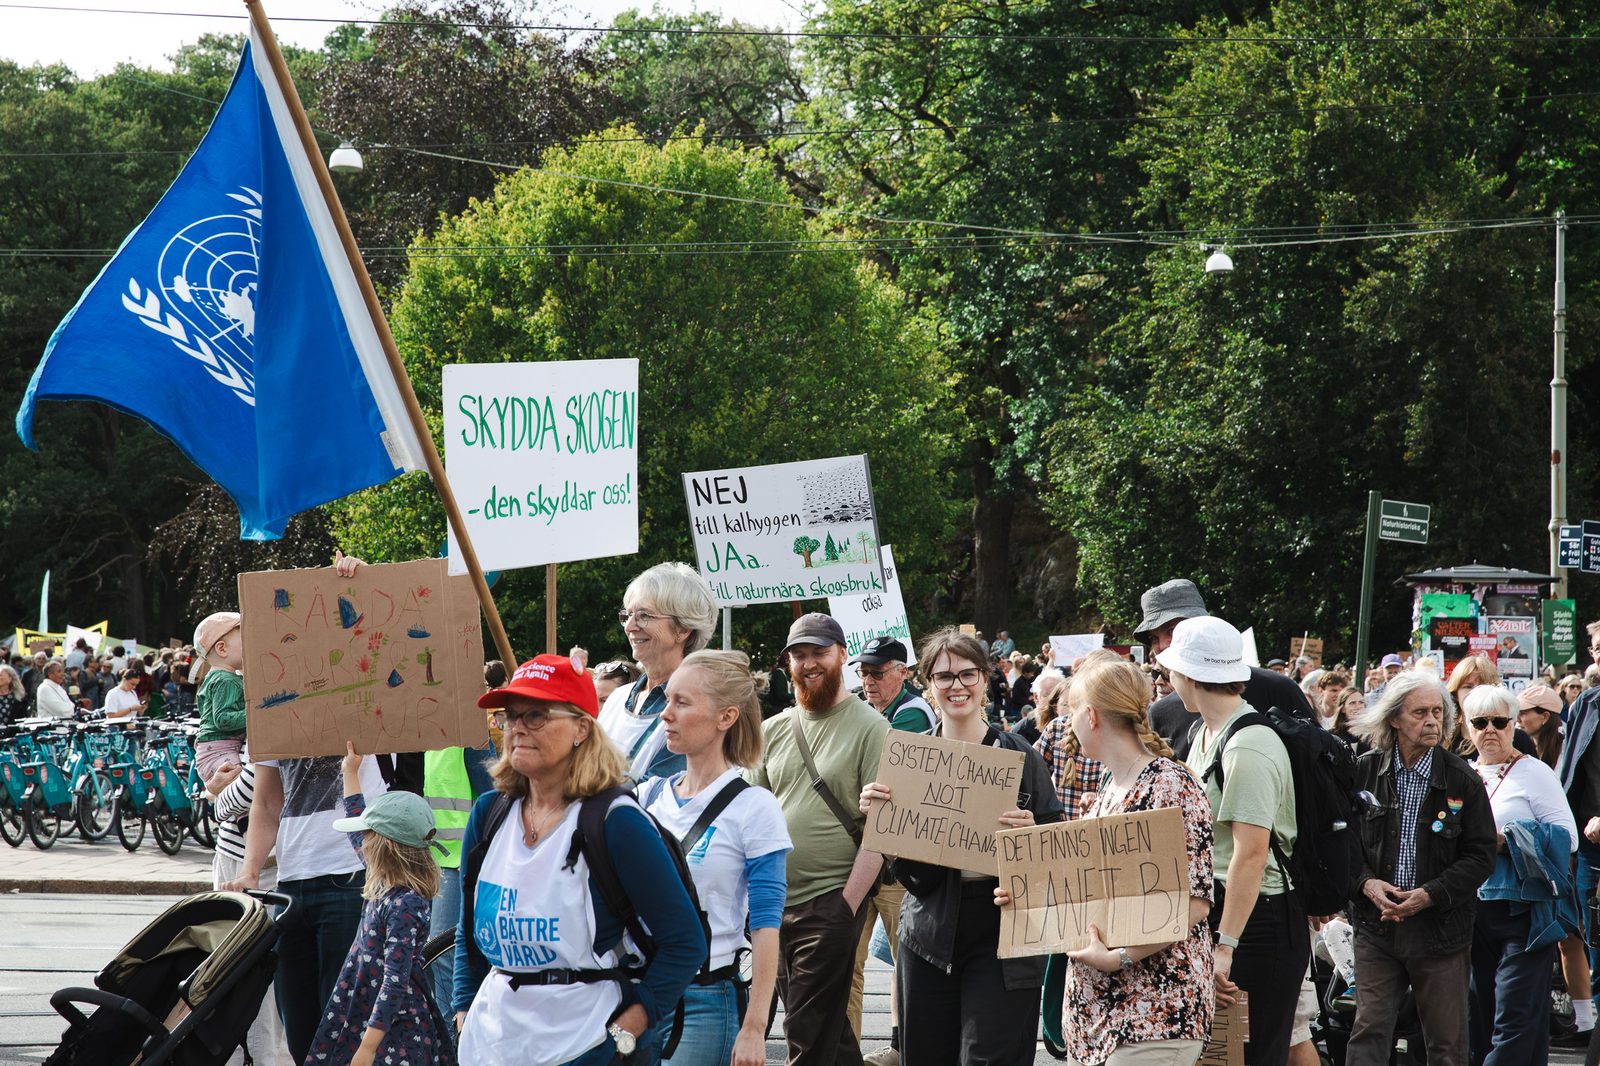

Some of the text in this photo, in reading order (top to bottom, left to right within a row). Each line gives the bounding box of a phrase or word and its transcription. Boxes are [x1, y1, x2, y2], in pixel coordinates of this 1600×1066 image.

[459, 388, 635, 455] SKYDDA SKOGEN
[527, 480, 597, 526] skyddar
[603, 473, 631, 505] oss!
[692, 475, 748, 507] NEJ
[695, 511, 801, 536] till kalhyggen
[1381, 530, 1400, 538] museet
[1382, 519, 1421, 531] Naturhistoriska
[735, 580, 805, 600] naturnära
[810, 572, 882, 598] skogsbruk
[272, 585, 424, 633] RÄDDA
[846, 632, 863, 657] ätt
[289, 696, 446, 746] NATUR
[888, 741, 1017, 791] SYSTEM CHANGE
[923, 782, 970, 809] NOT
[875, 800, 997, 858] CLIMATE CHANG
[1003, 817, 1152, 862] DET FINNS INGEN
[500, 887, 518, 913] EN
[1011, 857, 1182, 946] PLANET B!
[499, 912, 561, 942] BÄTTRE
[502, 942, 558, 967] VÄRLD
